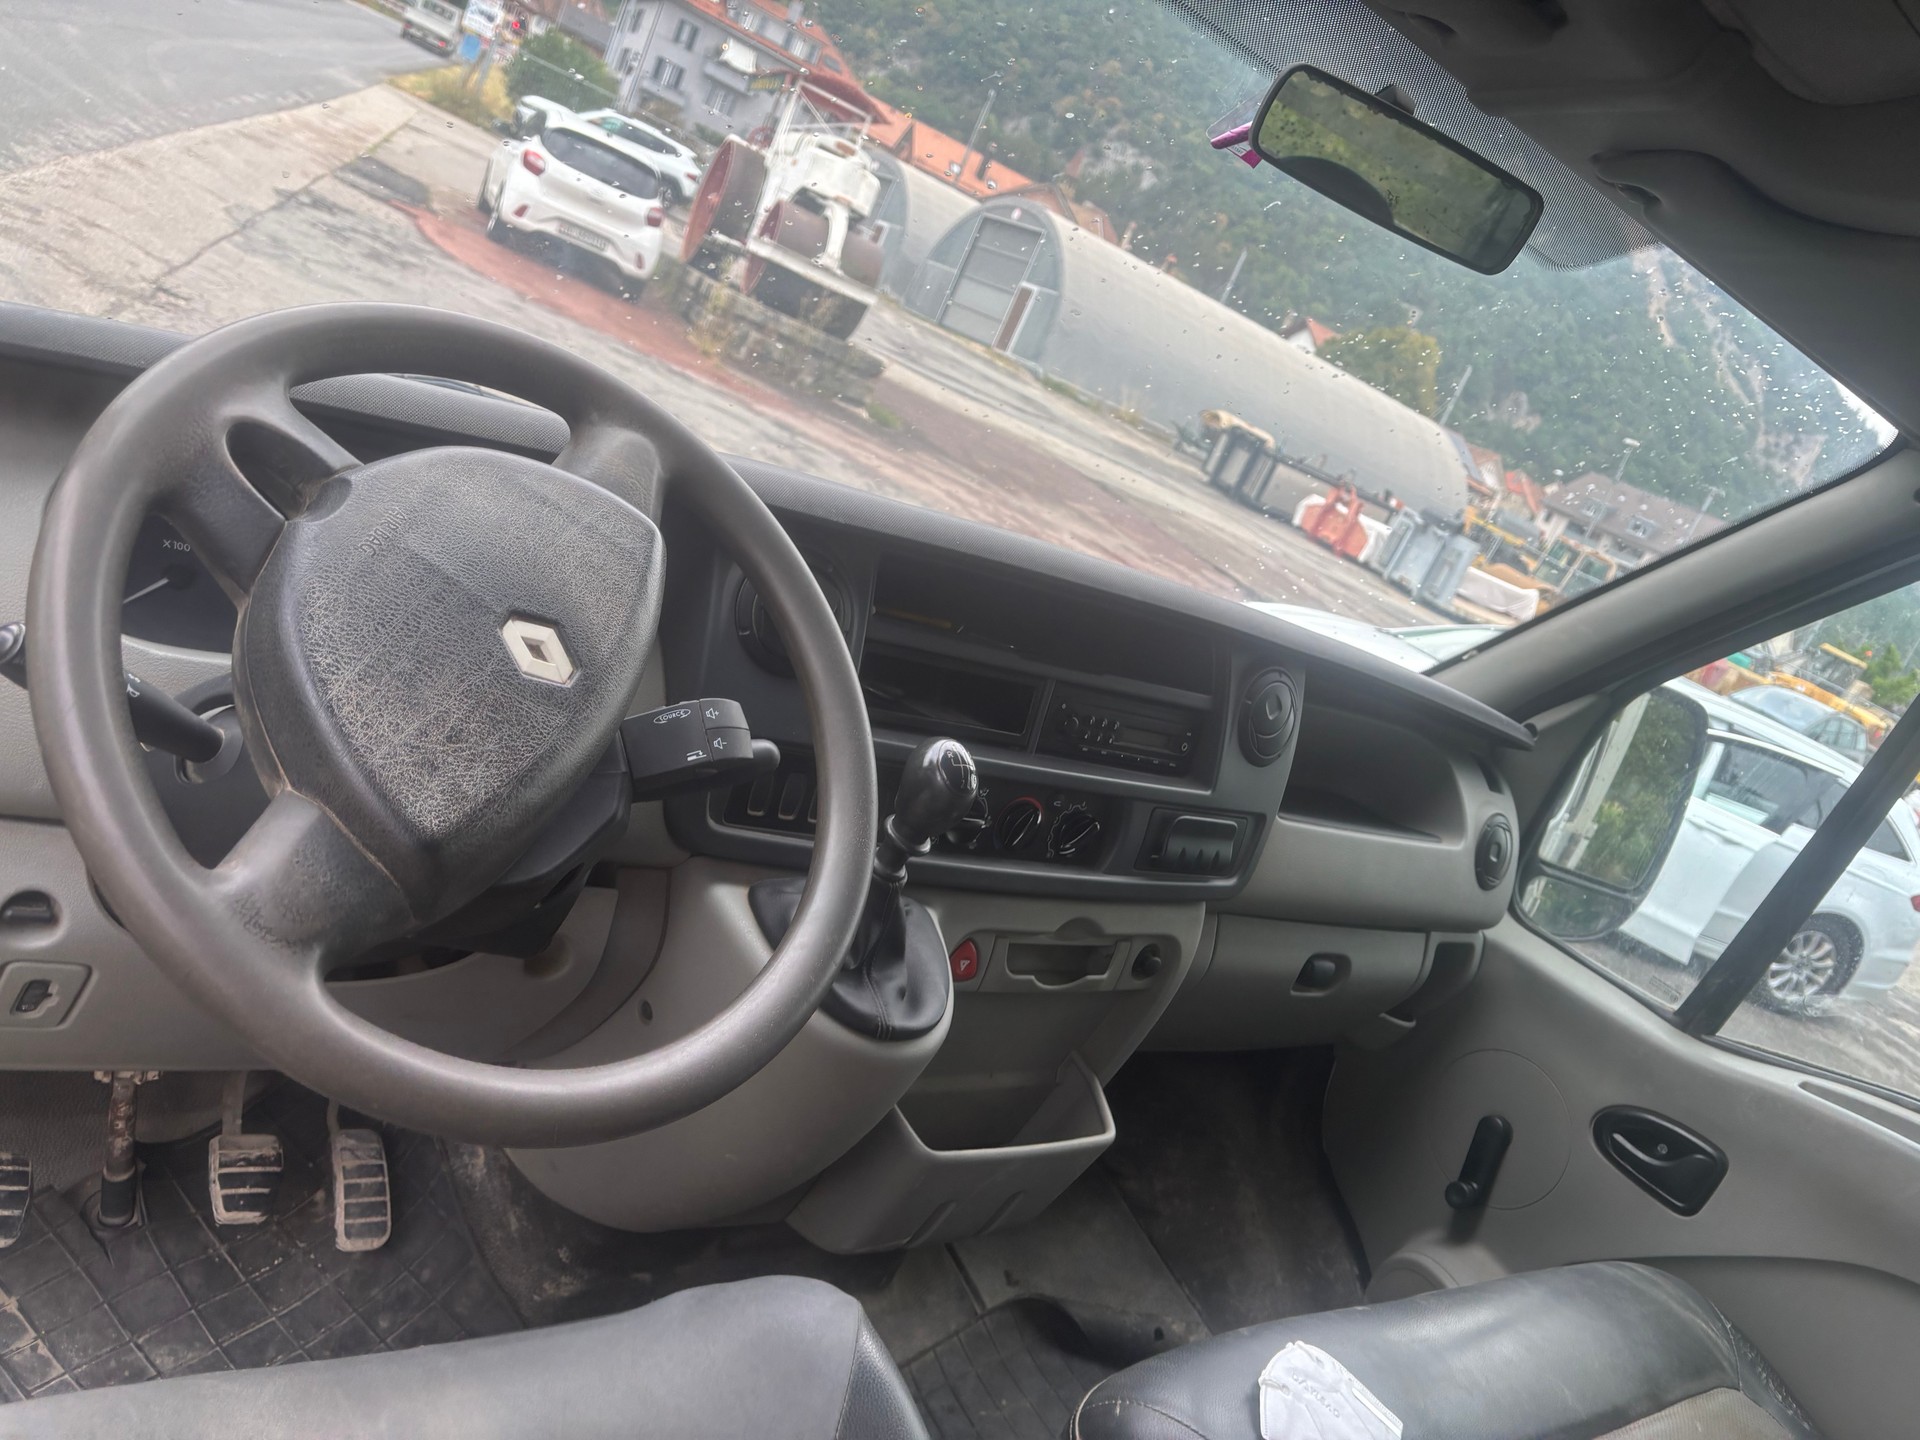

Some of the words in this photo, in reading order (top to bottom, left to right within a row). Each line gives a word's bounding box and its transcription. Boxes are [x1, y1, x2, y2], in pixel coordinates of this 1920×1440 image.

[380, 506, 407, 530] AIR
[359, 528, 390, 558] BAG
[946, 750, 955, 758] R
